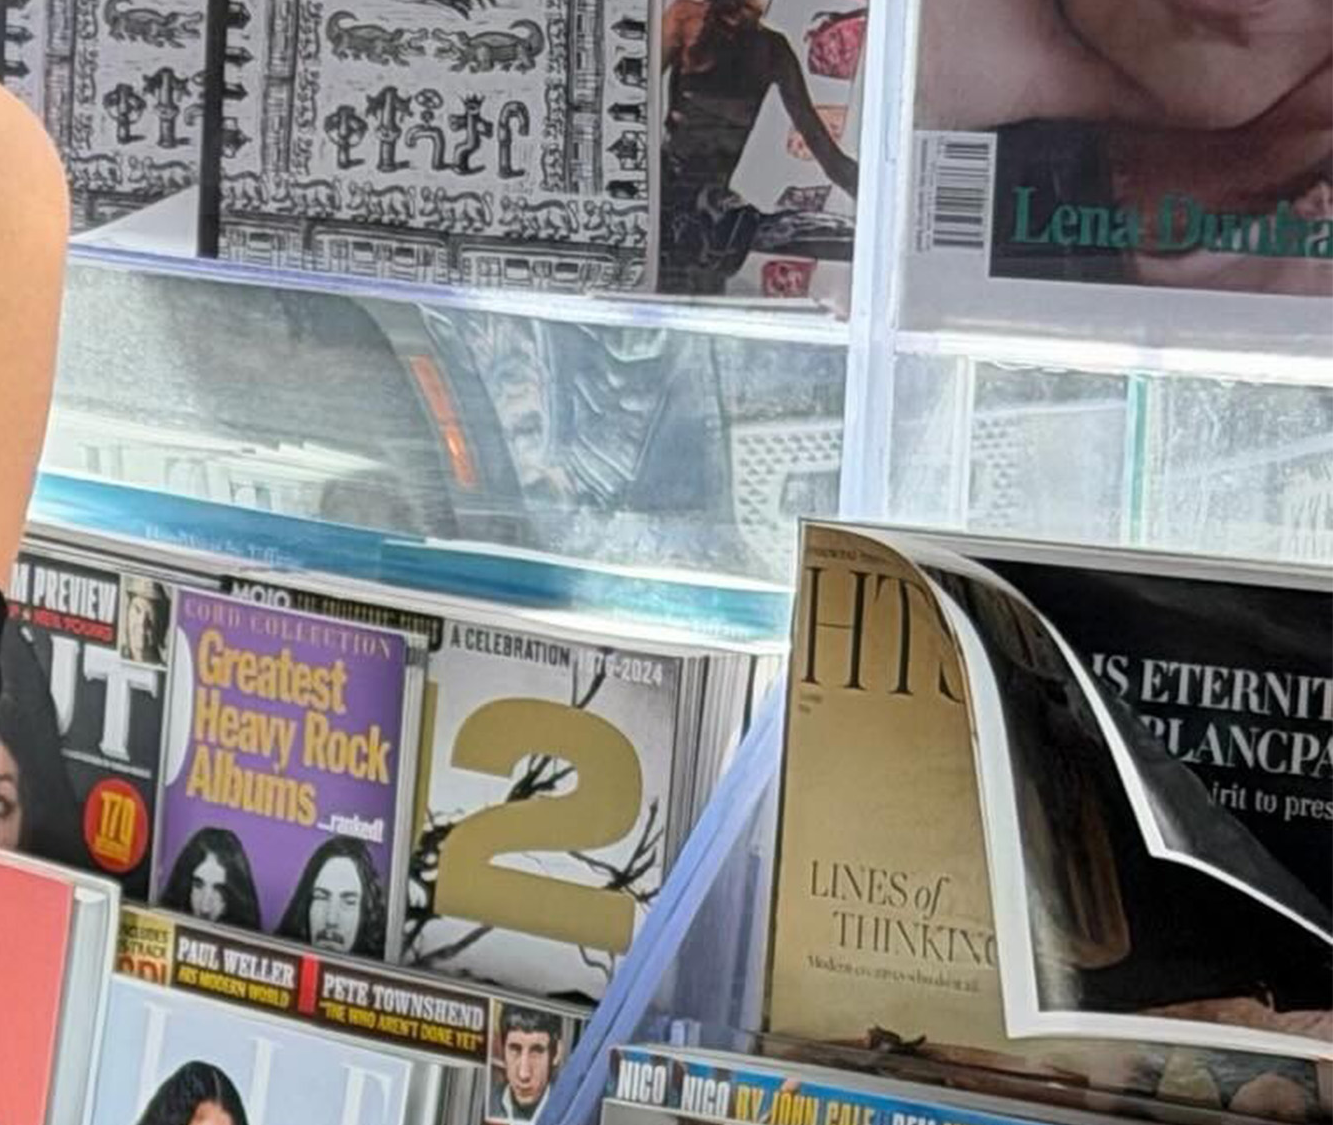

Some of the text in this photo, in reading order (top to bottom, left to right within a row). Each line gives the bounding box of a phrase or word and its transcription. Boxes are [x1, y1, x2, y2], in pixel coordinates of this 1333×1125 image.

[1011, 185, 1140, 248] Lena
[32, 565, 119, 625] PREVIEW
[197, 627, 348, 715] Greatest
[449, 628, 572, 669] A CELEBRATION
[193, 686, 392, 785] Heavy Rock
[185, 744, 318, 828] Albums
[1254, 787, 1278, 814] to
[1284, 793, 1333, 823] pres
[433, 697, 644, 947] 2
[808, 859, 952, 914] LINES of
[177, 936, 296, 990] PAUL WELLER
[247, 984, 291, 1010] WORLD
[322, 972, 485, 1032] PETE TOWNSHEND
[420, 1022, 455, 1048] DONE
[616, 1058, 667, 1105] NICO
[680, 1070, 732, 1119] NICO
[735, 1083, 765, 1124] BY
